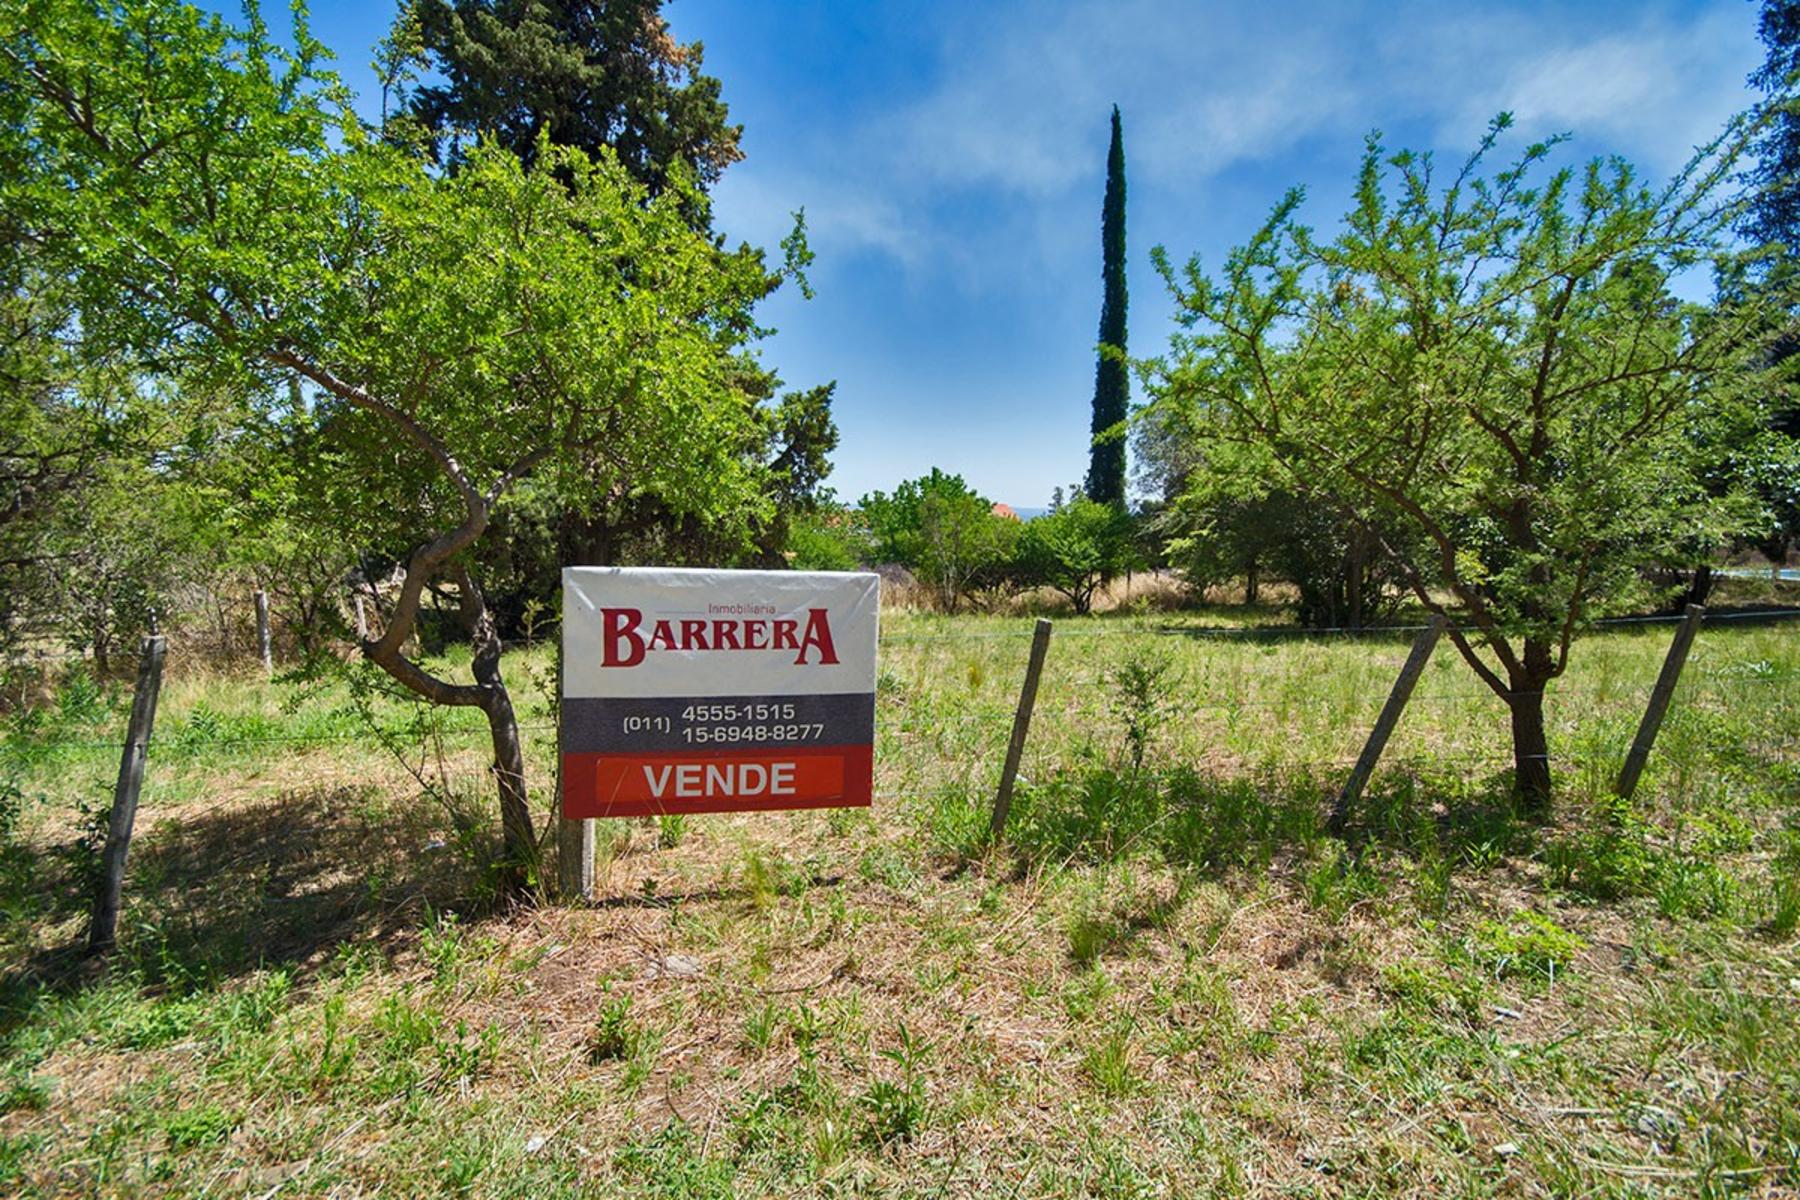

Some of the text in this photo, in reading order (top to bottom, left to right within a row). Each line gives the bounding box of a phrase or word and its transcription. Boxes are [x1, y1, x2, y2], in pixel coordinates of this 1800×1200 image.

[708, 603, 776, 615] Inmobiliaria
[600, 608, 840, 668] BARRERA
[682, 704, 795, 722] 4555-1515
[623, 716, 671, 734] (011)
[682, 724, 824, 743] 15-6948-8277
[642, 763, 796, 798] VENDE
